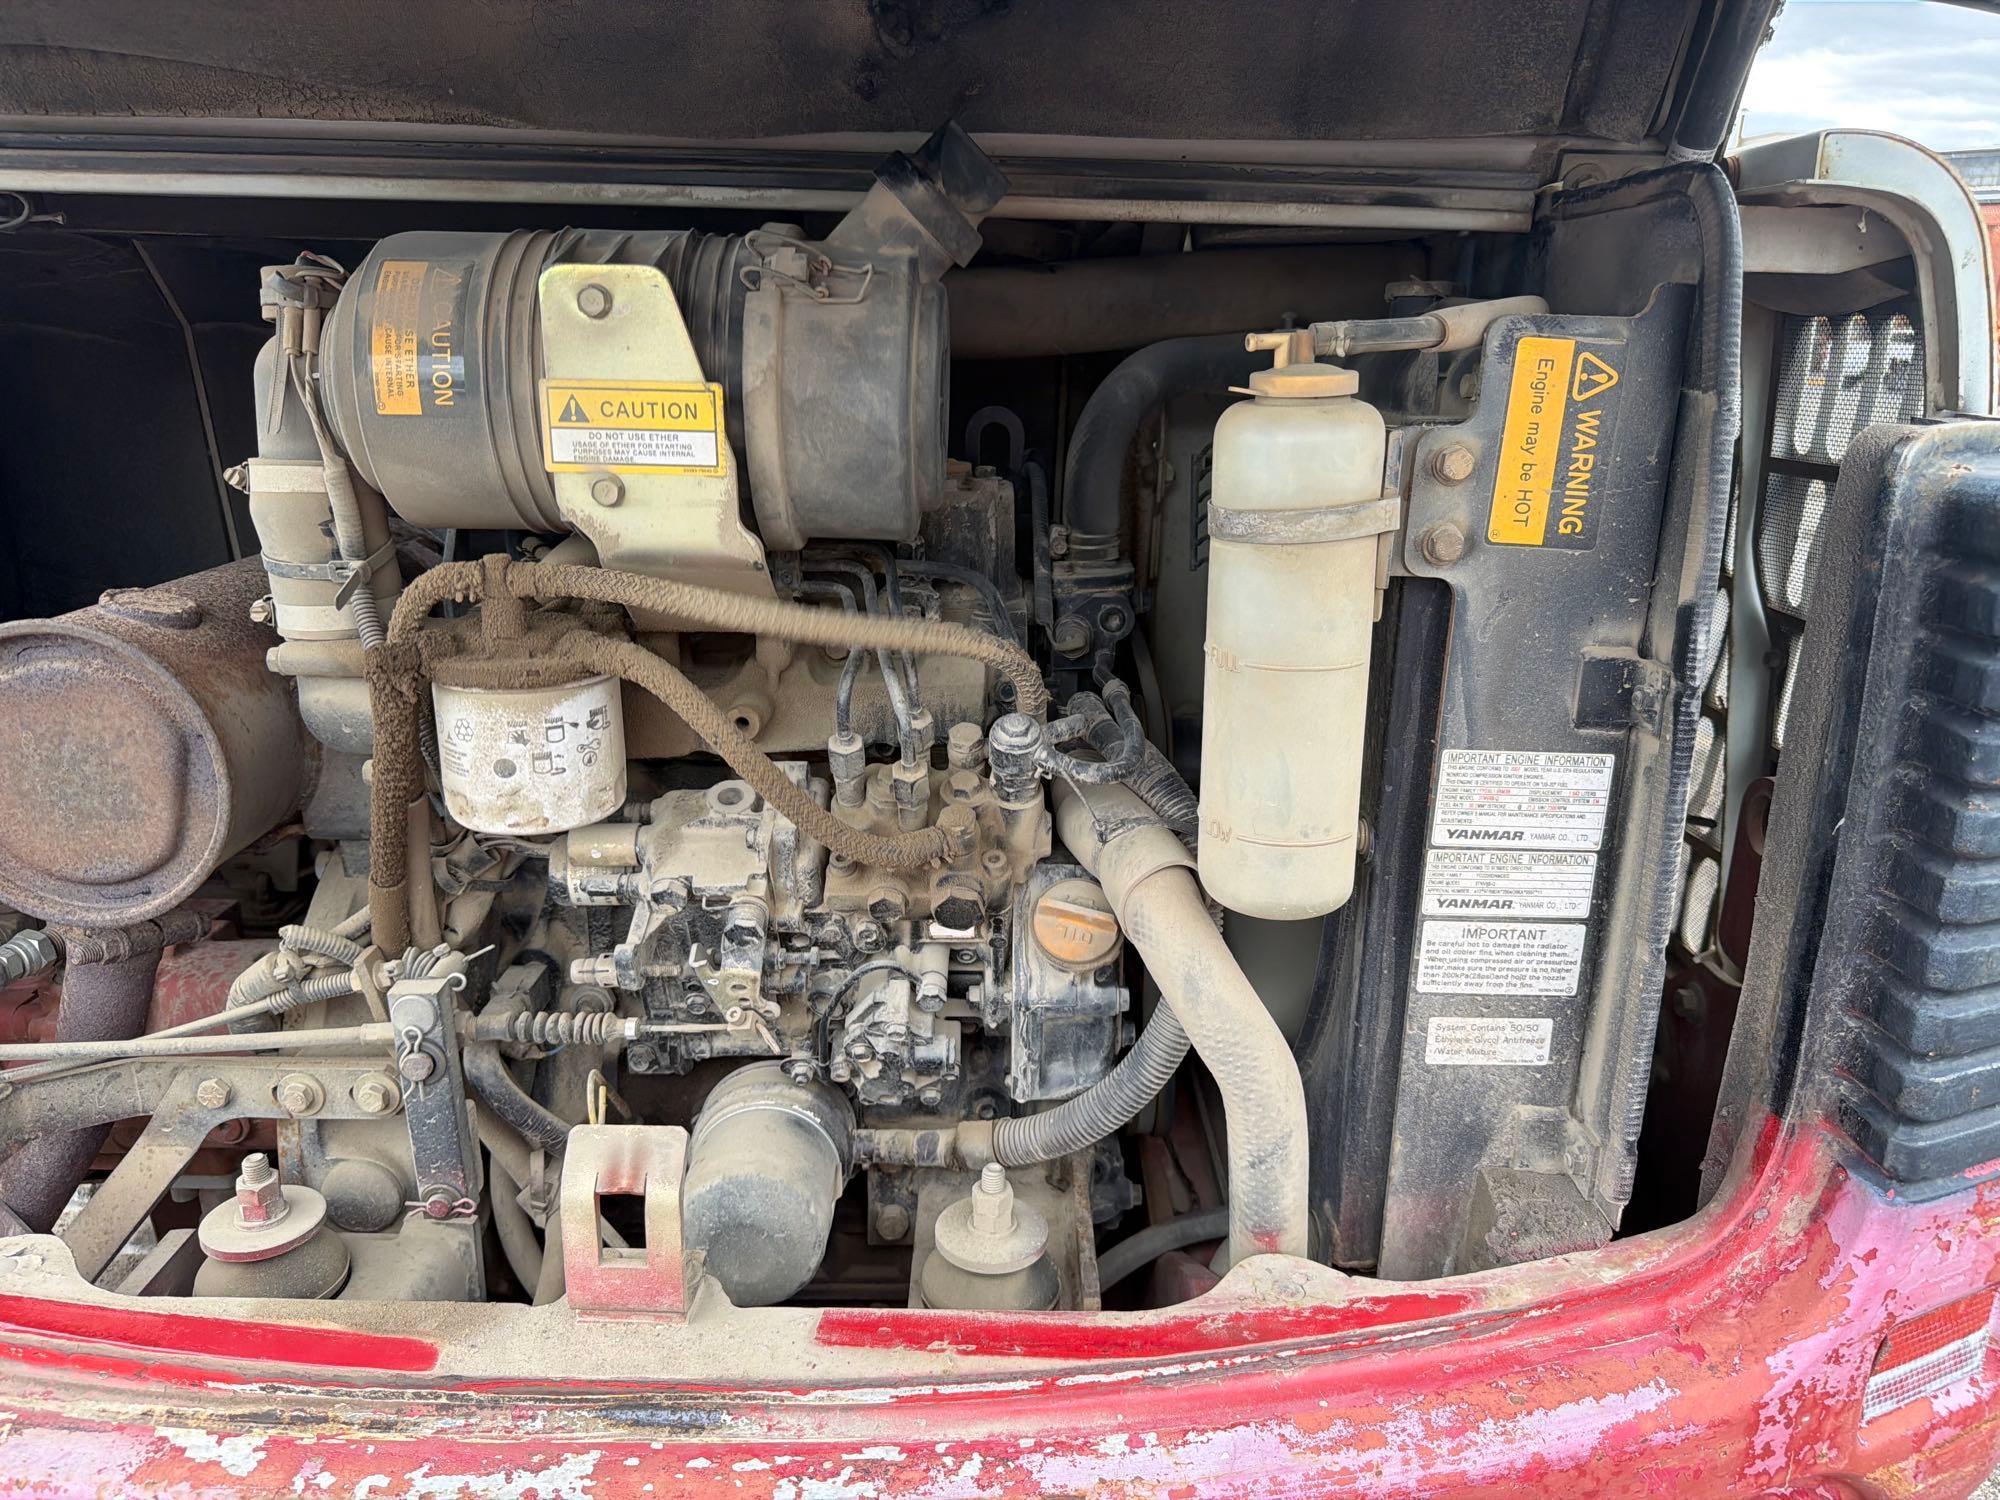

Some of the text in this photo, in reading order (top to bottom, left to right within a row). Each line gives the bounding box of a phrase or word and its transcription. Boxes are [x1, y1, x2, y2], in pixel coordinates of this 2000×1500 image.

[385, 328, 393, 355] CAUSE
[394, 355, 403, 396] STARTING
[405, 350, 414, 388] ETHER
[600, 400, 698, 420] CAUTION
[589, 432, 679, 441] DO NOT USE ETHER
[1513, 358, 1554, 527] Engine may be HOT
[1558, 410, 1602, 535] WARNING
[1448, 753, 1606, 767] IMPORTANT ENGINE INFORMATION
[1530, 833, 1557, 841] YANMAR
[1433, 853, 1589, 865] IMPORTANT ENGINE INFORMATION
[1462, 928, 1547, 940] IMPORTANT
[1550, 967, 1572, 975] higher
[1435, 1024, 1539, 1032] System Contains 50/50
[1435, 1036, 1545, 1045] Ethylene Glycol Antifreeze
